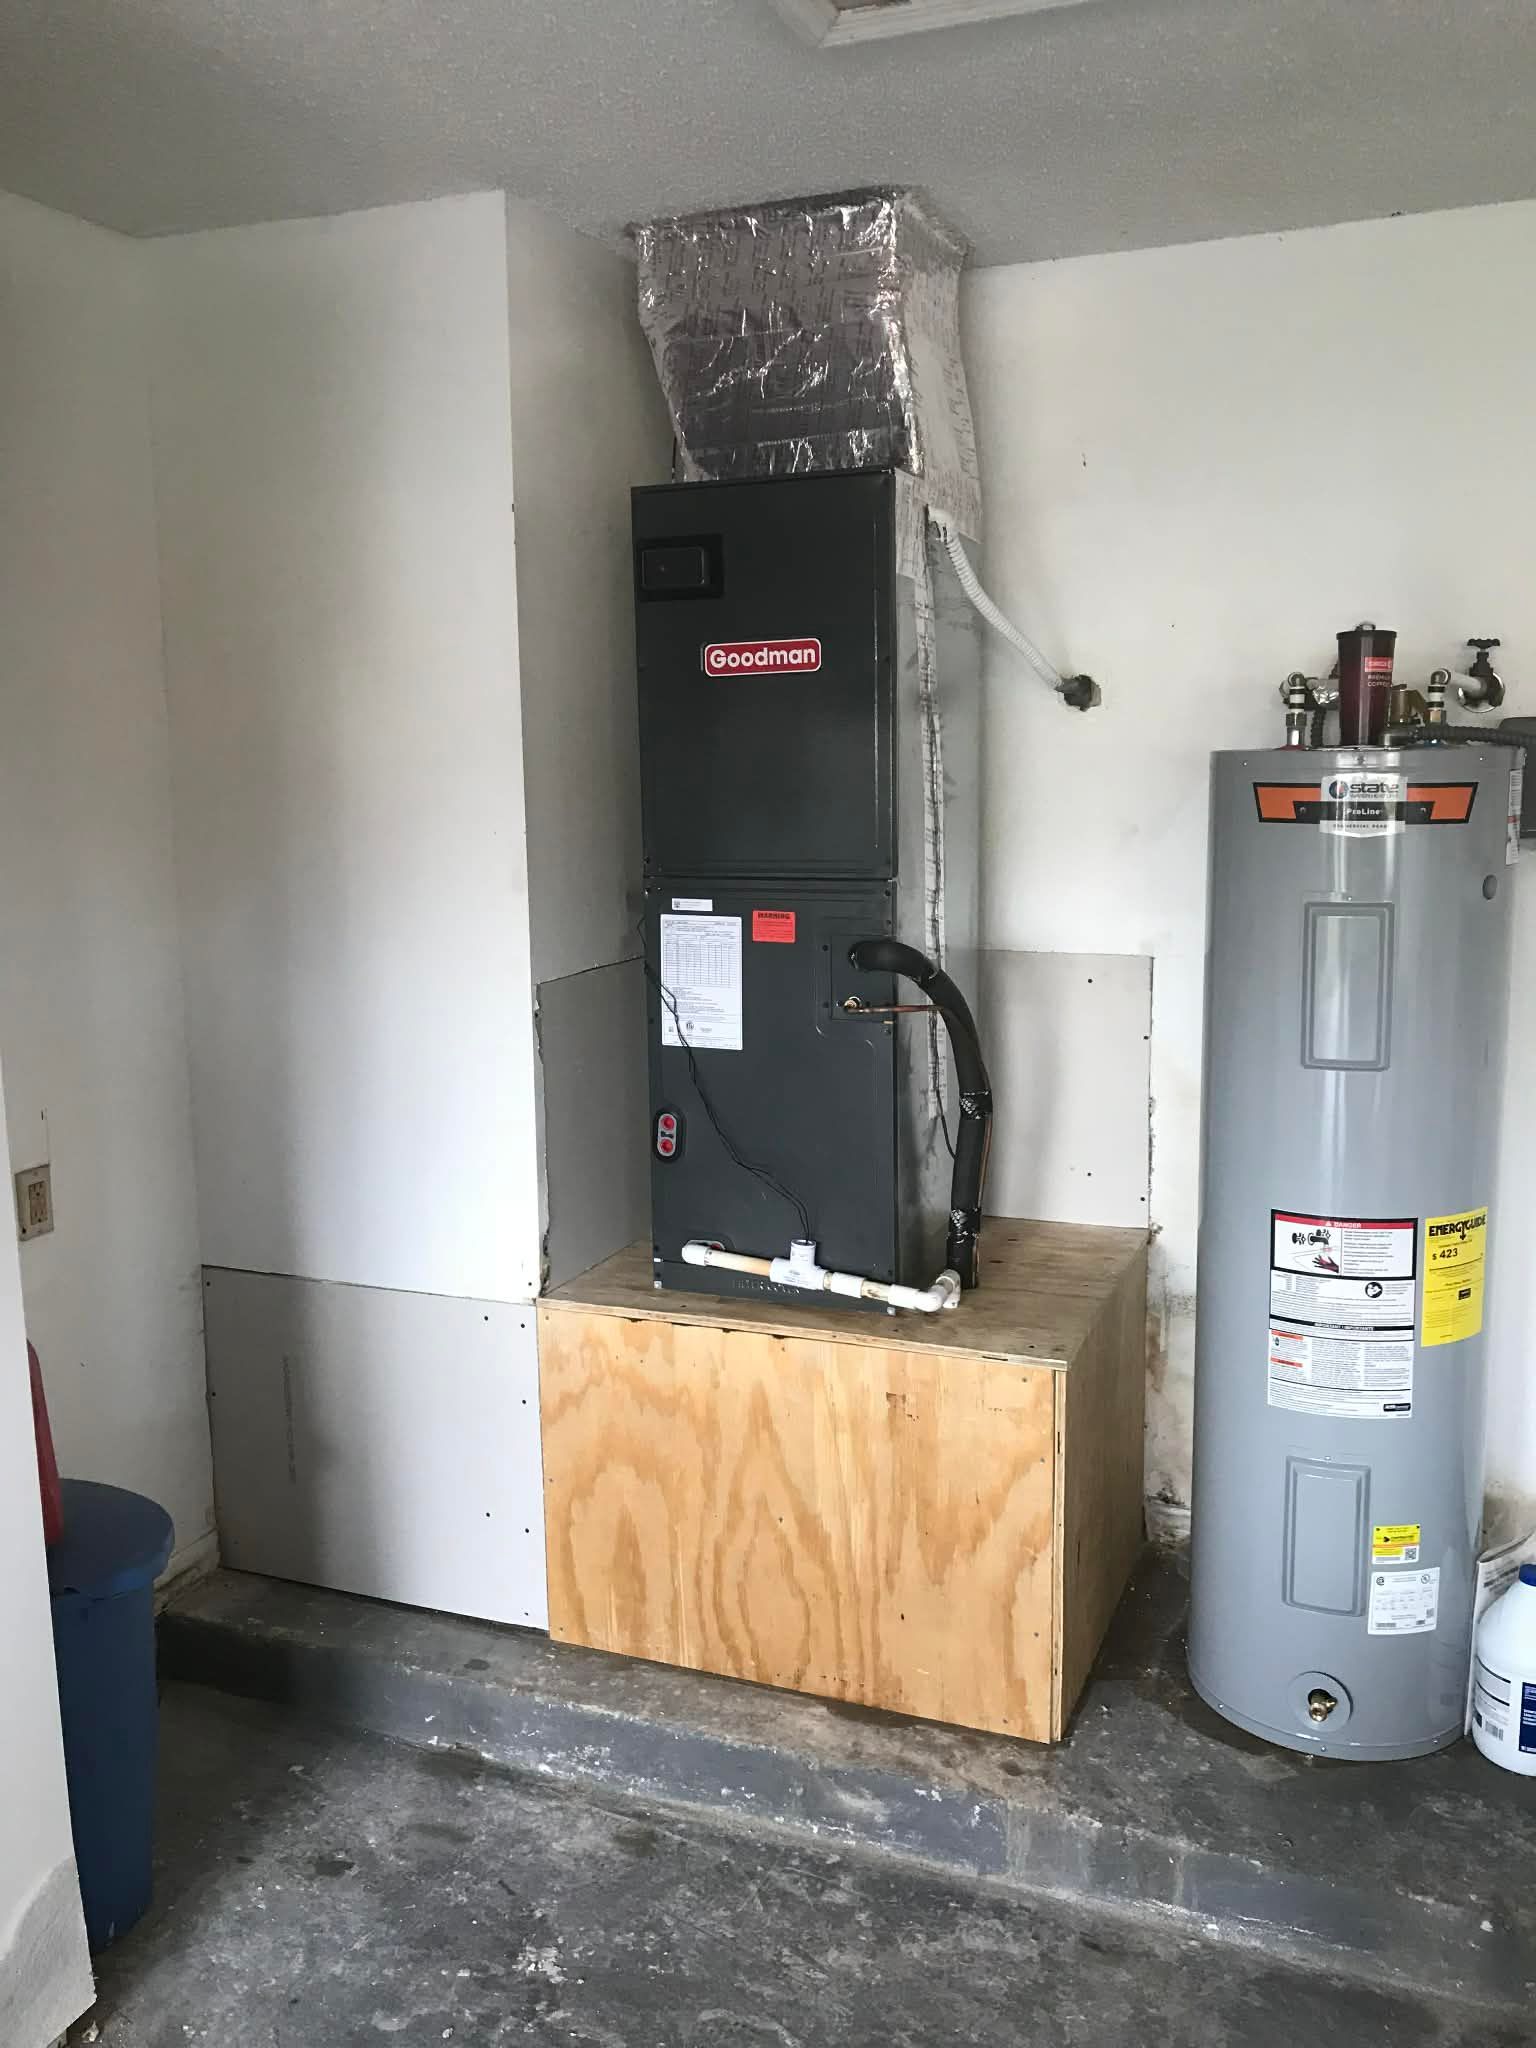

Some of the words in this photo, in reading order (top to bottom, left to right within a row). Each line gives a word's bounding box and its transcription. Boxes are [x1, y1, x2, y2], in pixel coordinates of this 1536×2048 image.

[710, 647, 816, 669] Goodman
[1350, 782, 1399, 793] state
[757, 911, 791, 920] WARNING
[1333, 1221, 1362, 1229] DANGER
[1439, 1247, 1458, 1259] 423
